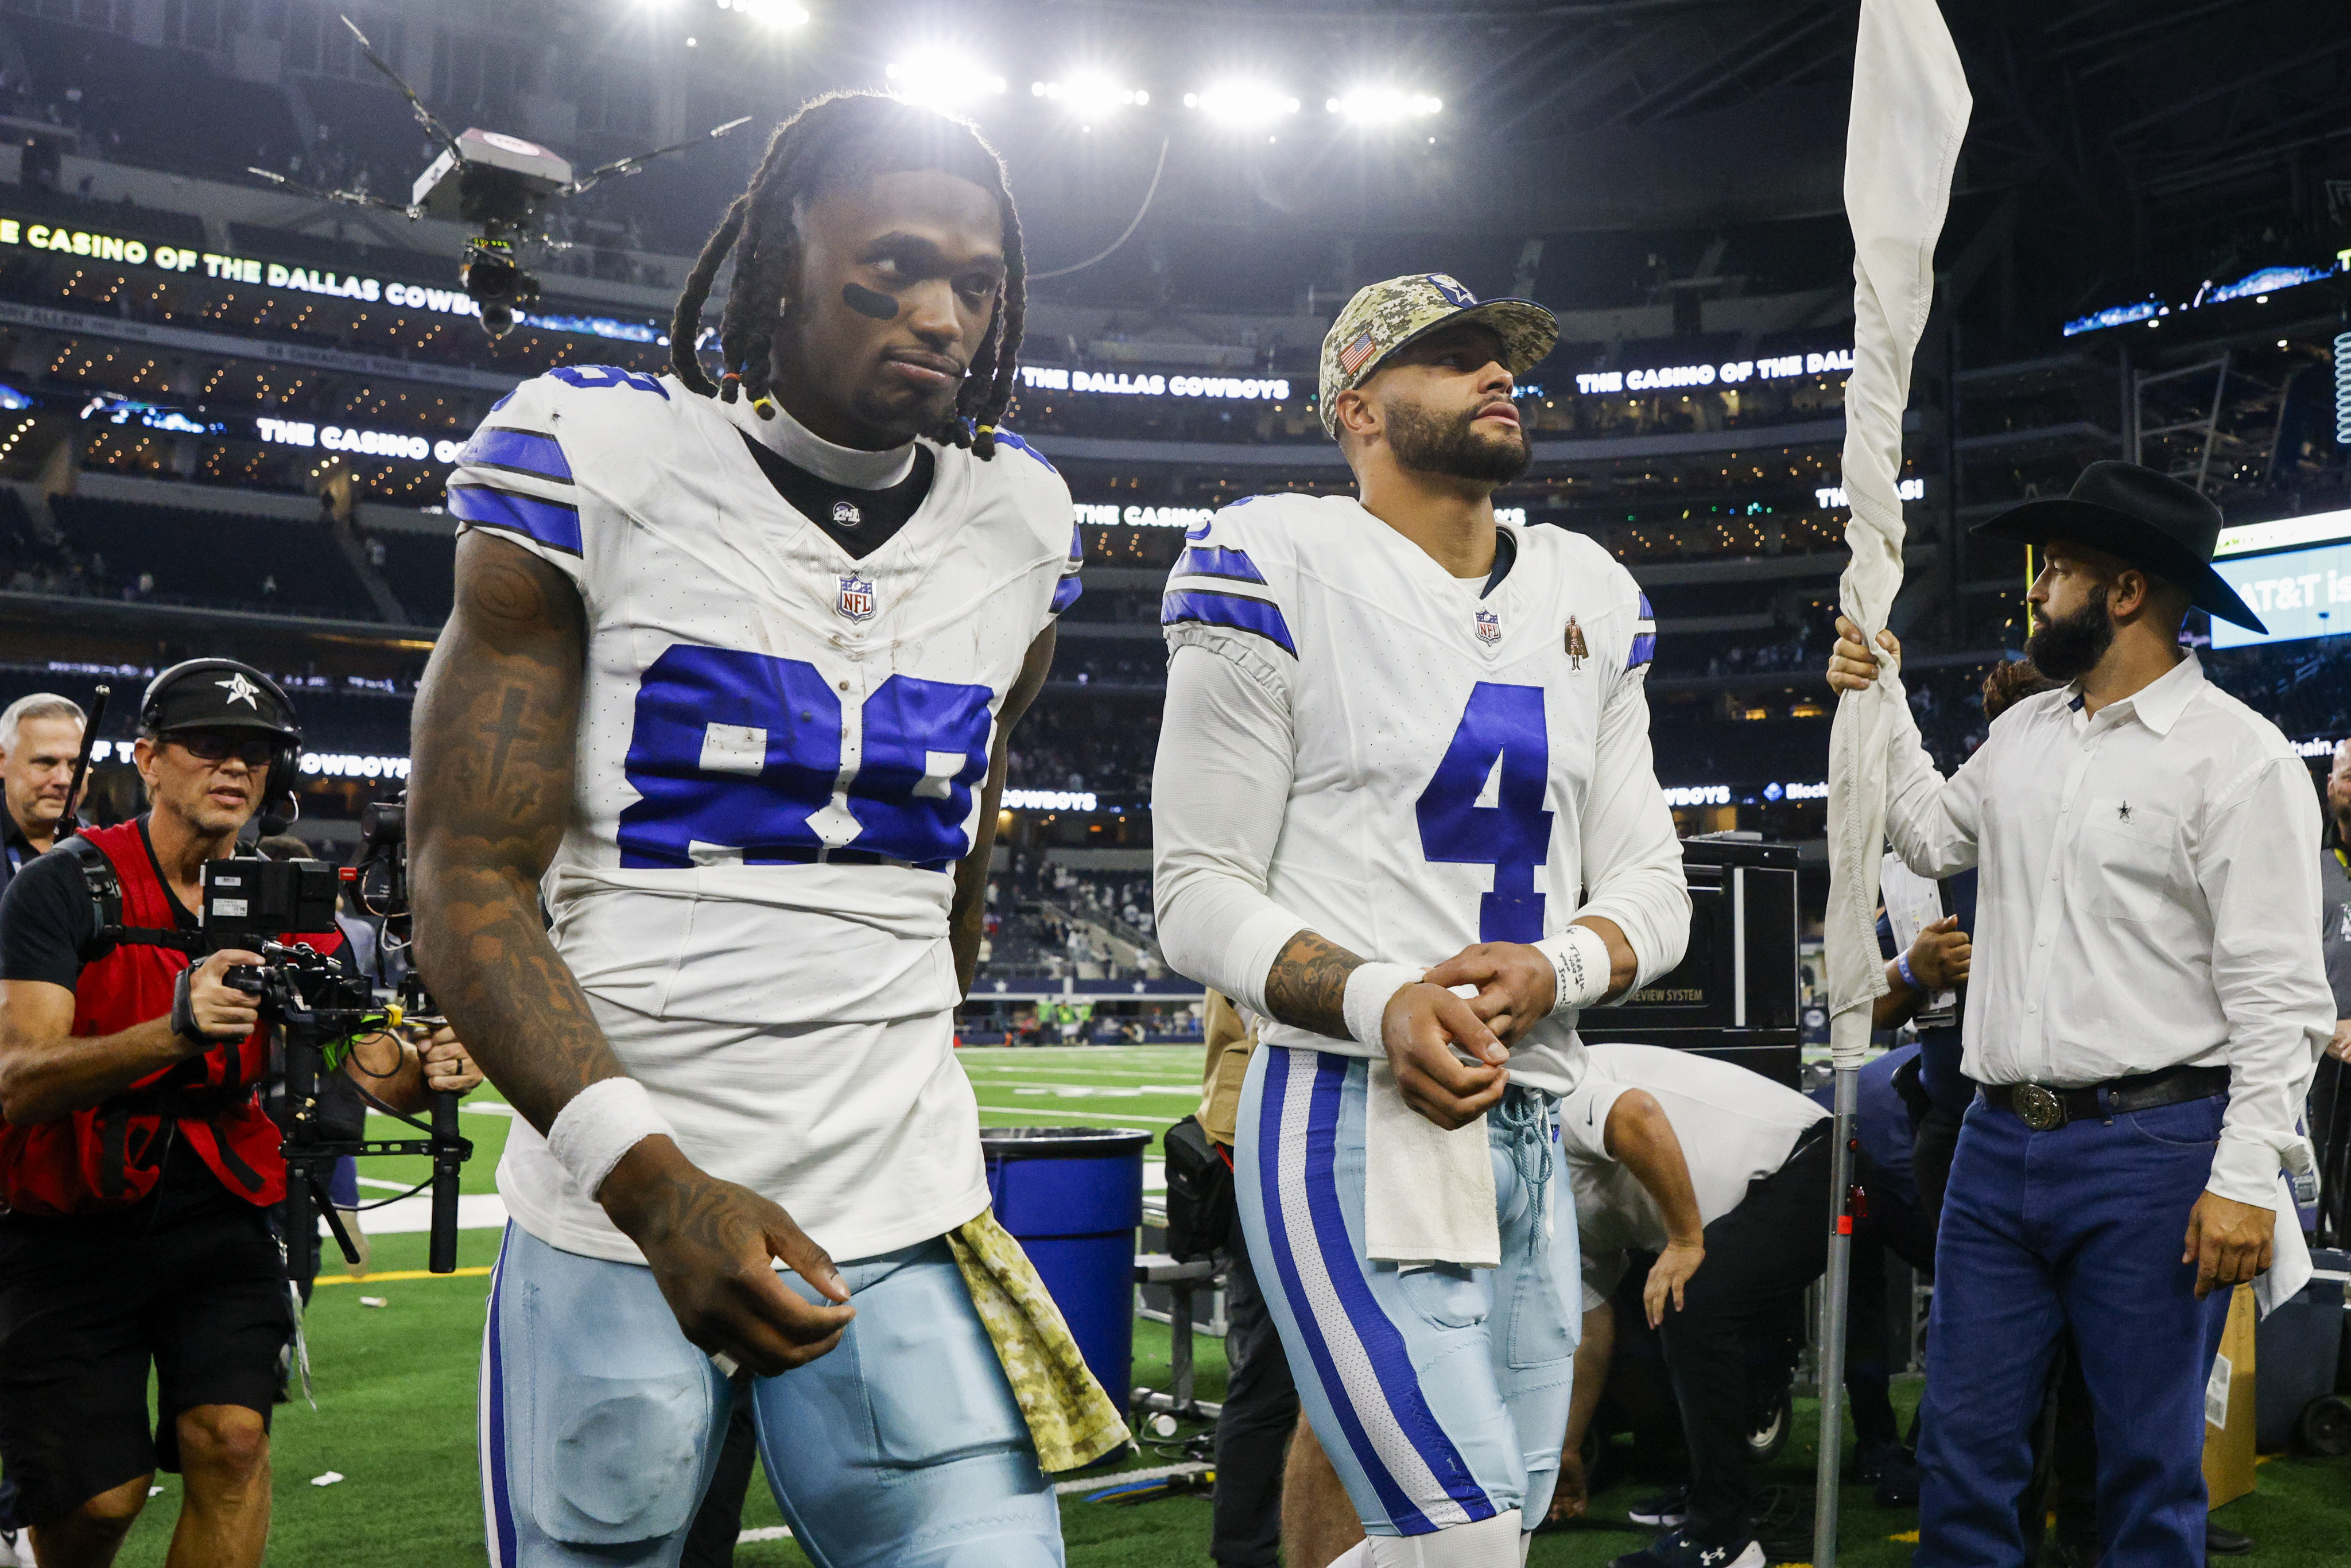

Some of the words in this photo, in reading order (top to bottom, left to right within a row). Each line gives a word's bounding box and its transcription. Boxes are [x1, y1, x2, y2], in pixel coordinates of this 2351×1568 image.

[27, 224, 148, 265] CASINO
[154, 246, 197, 272] OF
[203, 253, 262, 284] THE
[267, 262, 381, 302] DALLAS
[1021, 366, 1069, 390] THE
[1072, 371, 1166, 395] DALLAS
[1169, 375, 1290, 399] COWBOYS
[1576, 371, 1623, 394] THE
[1626, 364, 1716, 390] CASINO
[1720, 361, 1753, 383] OF
[1756, 355, 1803, 379] THE
[1807, 348, 1855, 373] DAL
[257, 417, 316, 447] THE
[320, 426, 430, 460] CASINO
[1073, 503, 1120, 525] THE
[844, 593, 870, 613] NFL
[2240, 573, 2322, 613] AT&T
[1479, 623, 1498, 638] NFL
[298, 752, 412, 779] OWBOYS
[617, 643, 993, 874] 88
[1786, 781, 1829, 799] Block
[1415, 681, 1554, 944] 4
[1569, 943, 1585, 993] THANK
[1666, 988, 1703, 1002] SYSTEM
